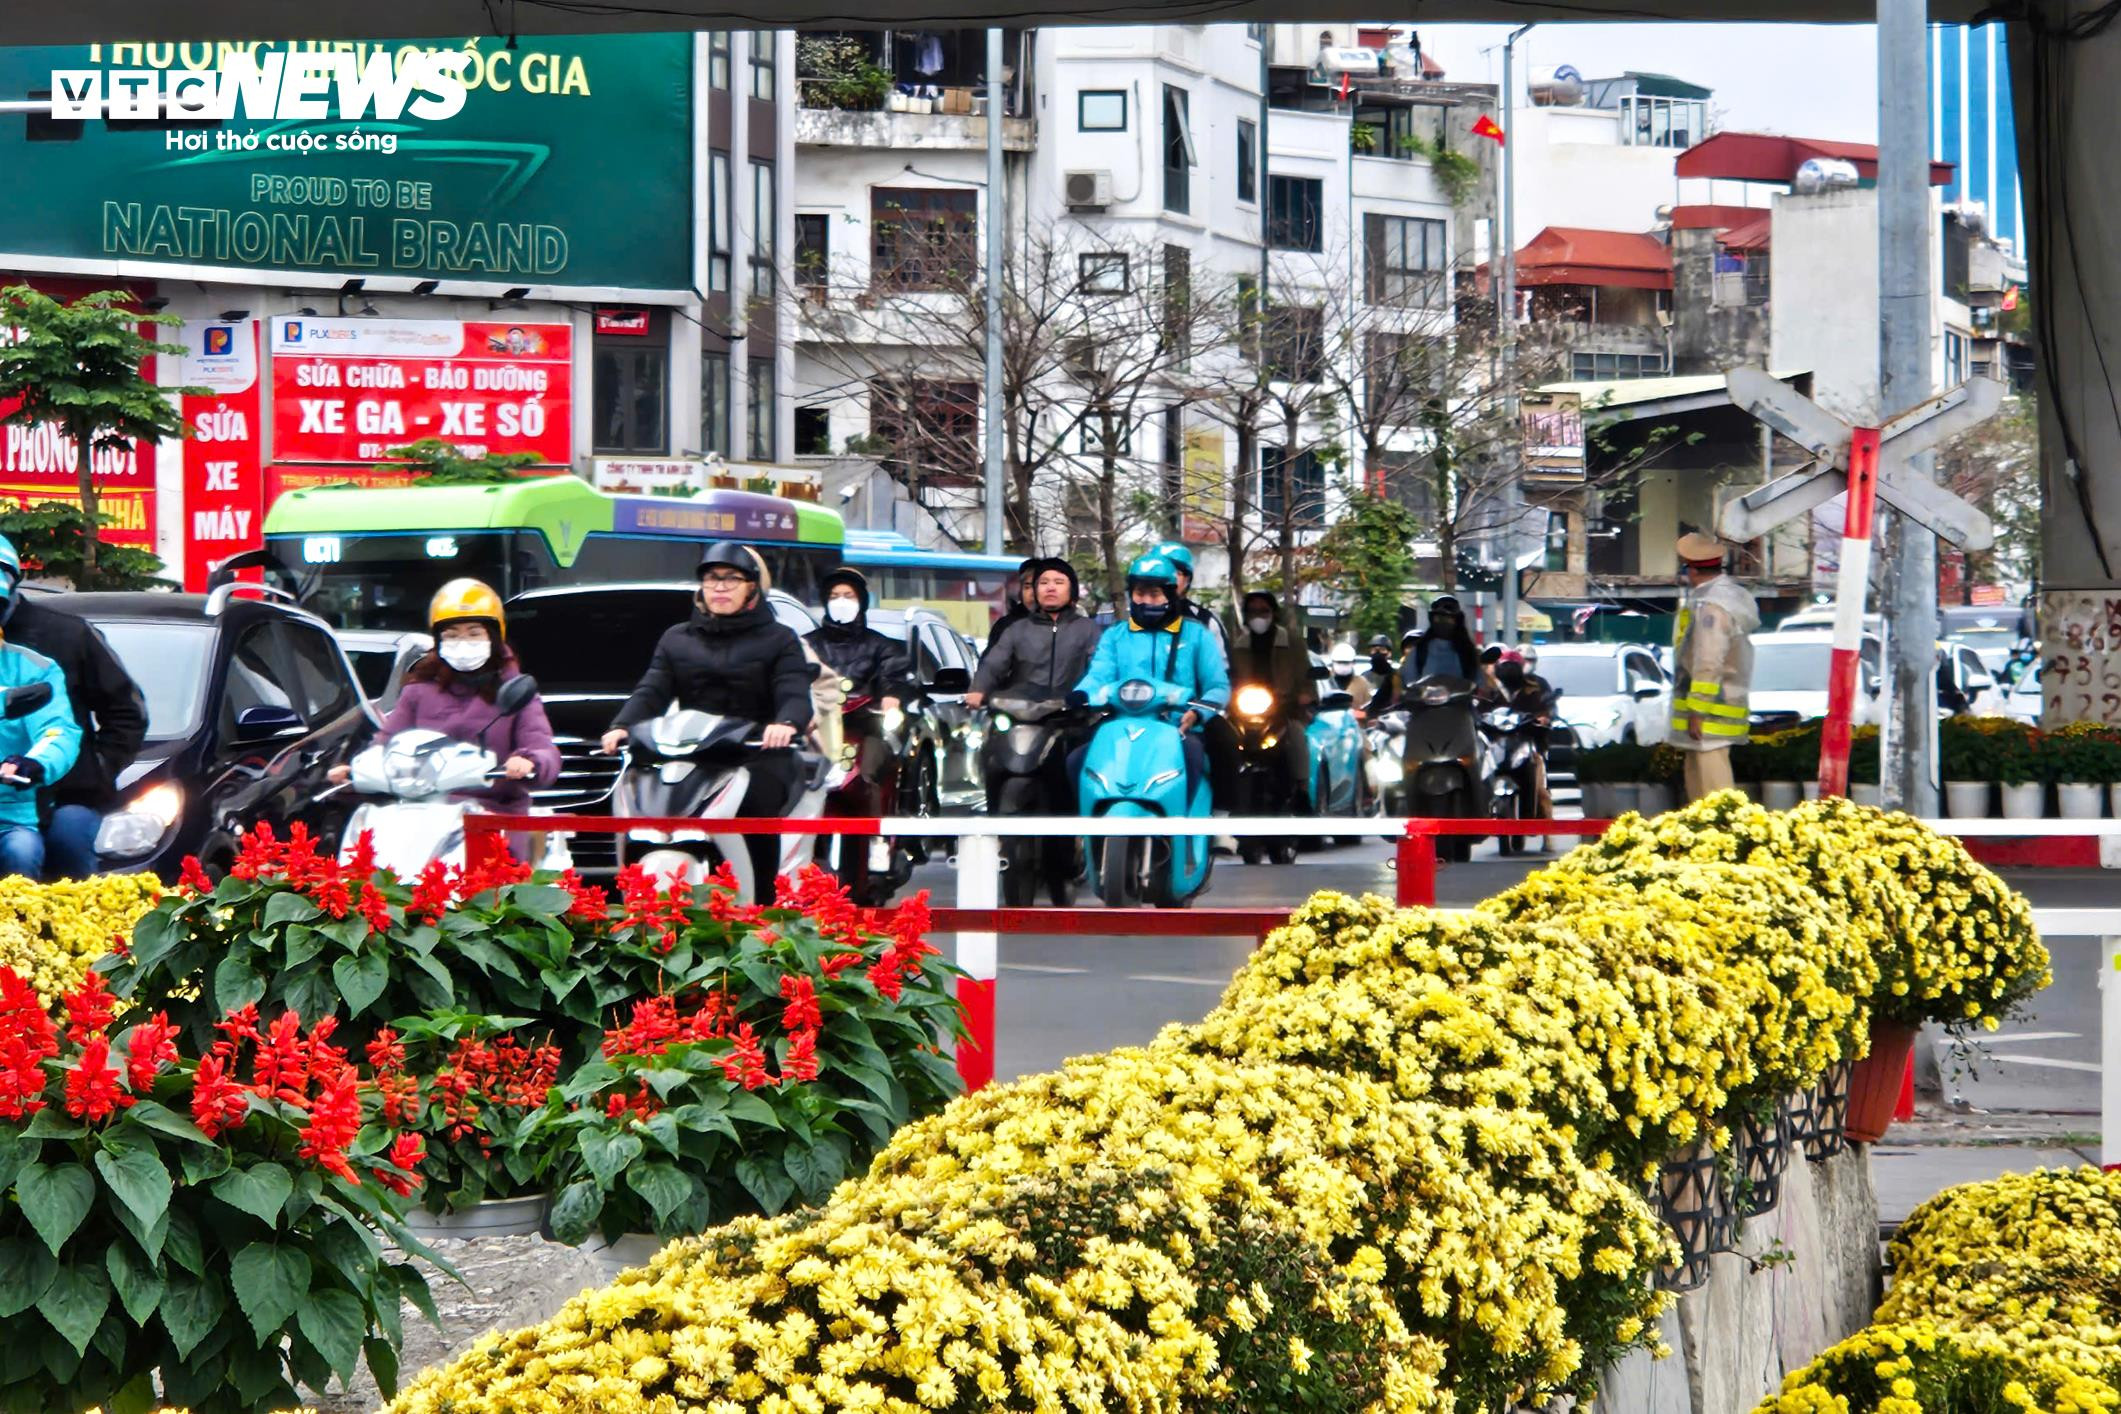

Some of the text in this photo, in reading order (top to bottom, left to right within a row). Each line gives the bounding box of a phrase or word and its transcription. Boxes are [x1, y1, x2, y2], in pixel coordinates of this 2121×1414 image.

[519, 52, 591, 96] GIA
[251, 173, 432, 210] PROUD TO BE
[103, 201, 569, 274] NATIONAL BRAND
[297, 358, 341, 388] SỬA
[346, 362, 405, 389] CHỮA
[424, 361, 469, 390] BẢO
[196, 403, 248, 442] SỬA
[299, 399, 346, 434] XE
[356, 401, 405, 435] GA
[440, 402, 486, 436] XE
[496, 392, 545, 437] SỐ
[205, 461, 239, 491] XE
[194, 505, 251, 541] MÁY
